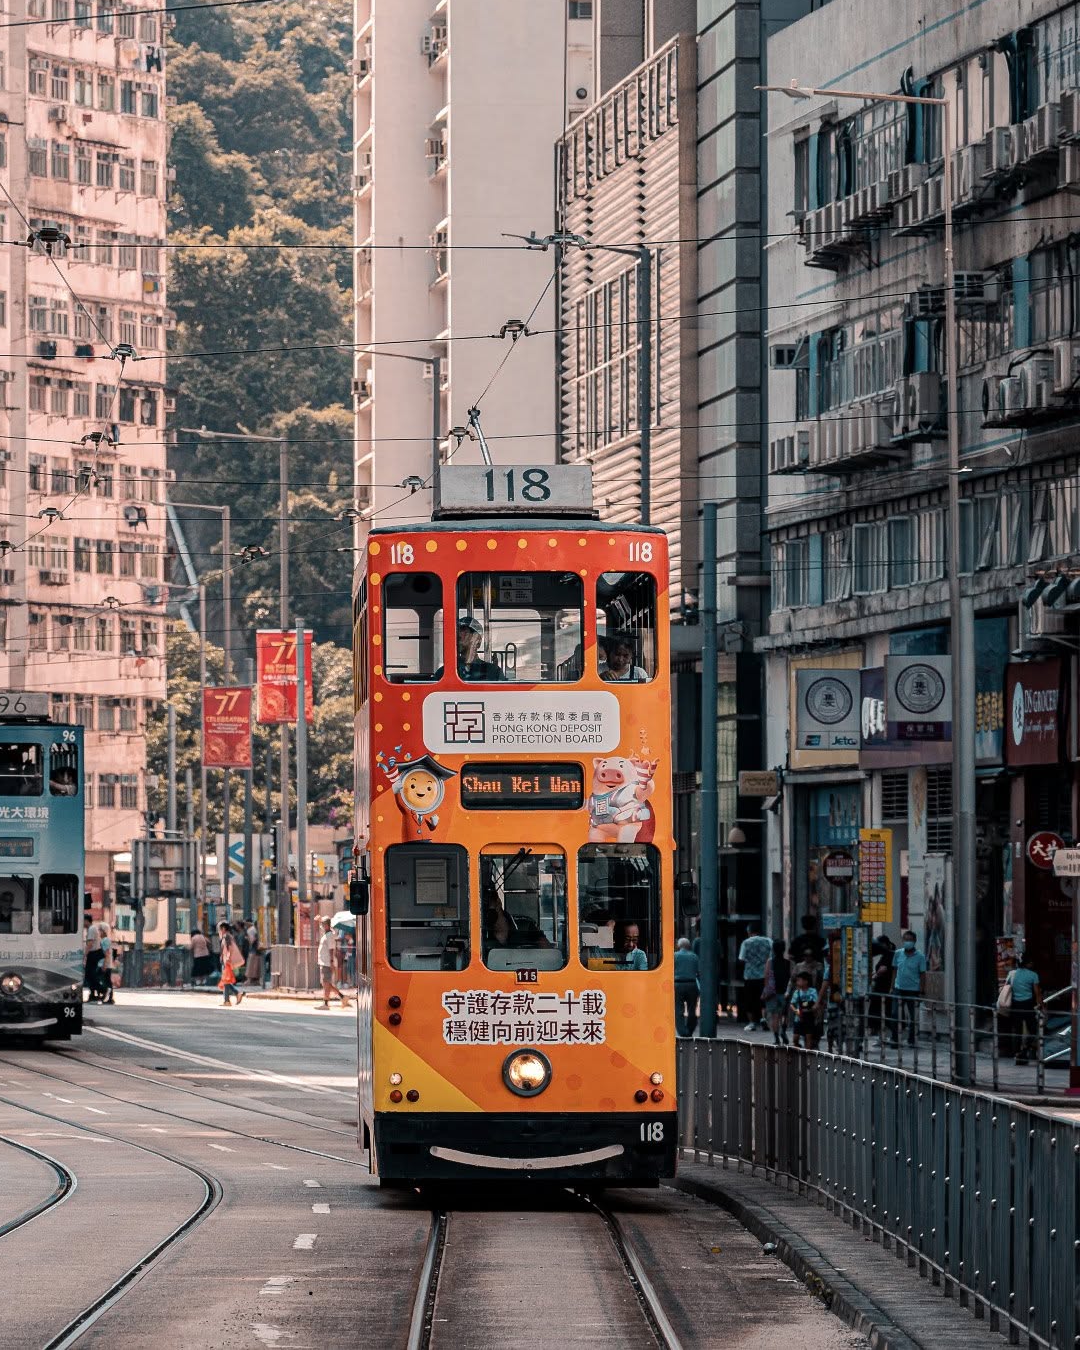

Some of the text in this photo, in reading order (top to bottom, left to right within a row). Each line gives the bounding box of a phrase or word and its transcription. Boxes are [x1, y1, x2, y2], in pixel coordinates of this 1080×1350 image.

[482, 468, 551, 502] 118
[391, 544, 414, 565] 118
[629, 541, 653, 562] 118
[215, 691, 241, 716] 77
[493, 712, 603, 722] 香港存款保障委員會
[62, 730, 76, 742] 96
[493, 724, 603, 733] HONG KONG DEPOSIT
[493, 735, 603, 744] PROTECTION BOARD
[512, 777, 541, 793] Kei
[550, 777, 582, 793] Wan
[517, 971, 537, 981] 115
[64, 1006, 76, 1018] 96
[445, 993, 603, 1016] 守護存款二十載
[446, 1020, 603, 1042] 穩健向前迎未來
[640, 1122, 664, 1142] 118
